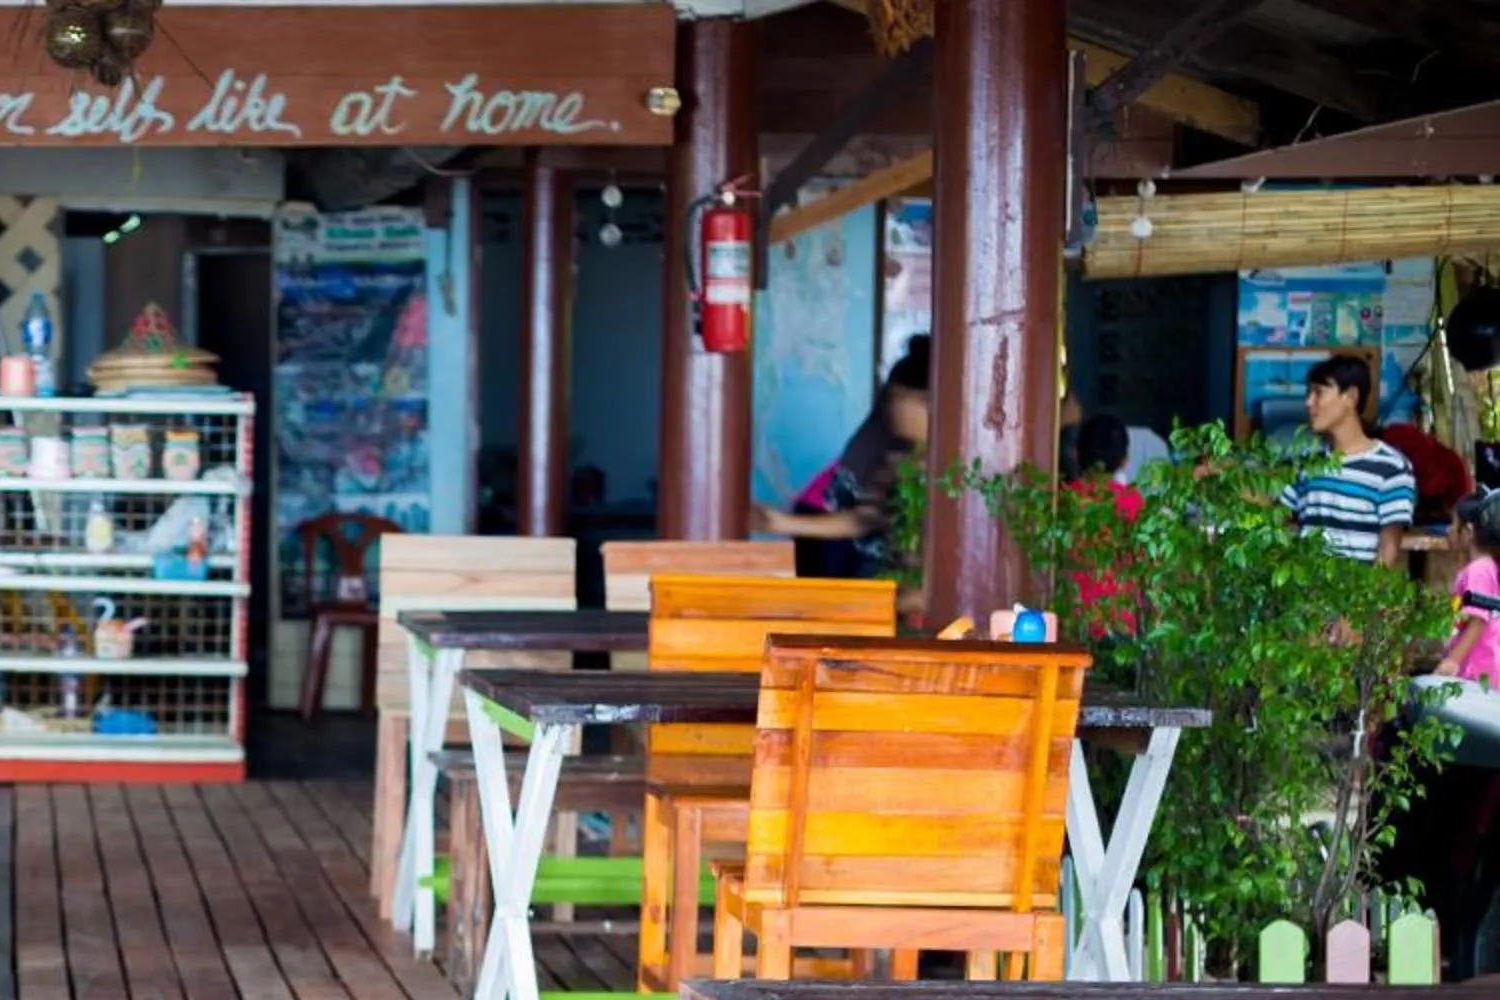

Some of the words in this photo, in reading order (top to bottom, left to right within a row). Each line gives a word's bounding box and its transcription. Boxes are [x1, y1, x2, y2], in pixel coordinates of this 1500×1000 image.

[46, 74, 175, 143] self
[186, 69, 301, 136] like
[329, 74, 418, 135] at
